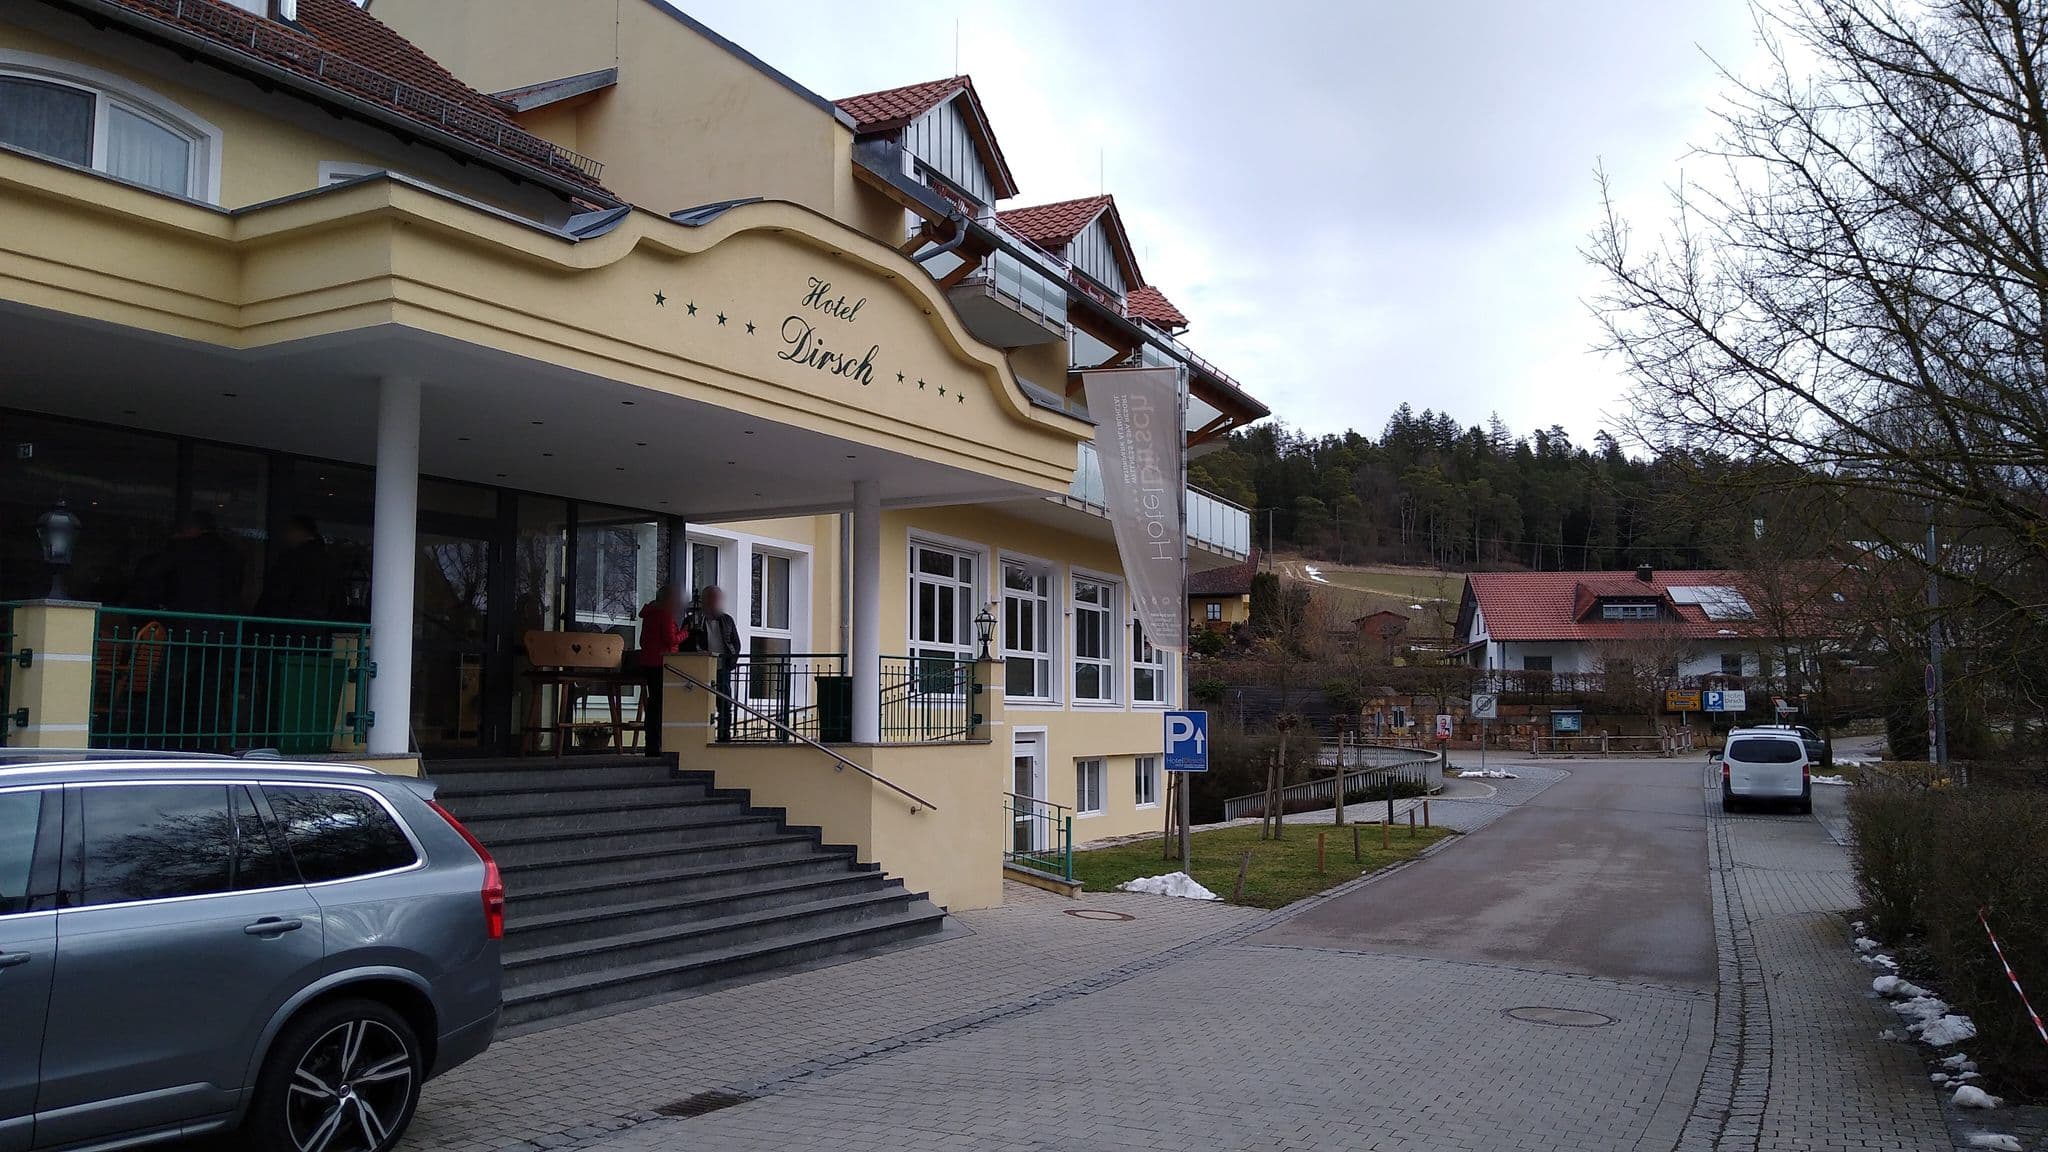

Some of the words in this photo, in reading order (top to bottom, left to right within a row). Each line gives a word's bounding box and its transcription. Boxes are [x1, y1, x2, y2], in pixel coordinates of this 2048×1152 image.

[801, 276, 867, 323] Hotel
[777, 315, 880, 386] Dirsch
[1709, 692, 1720, 705] P
[1166, 715, 1194, 754] P
